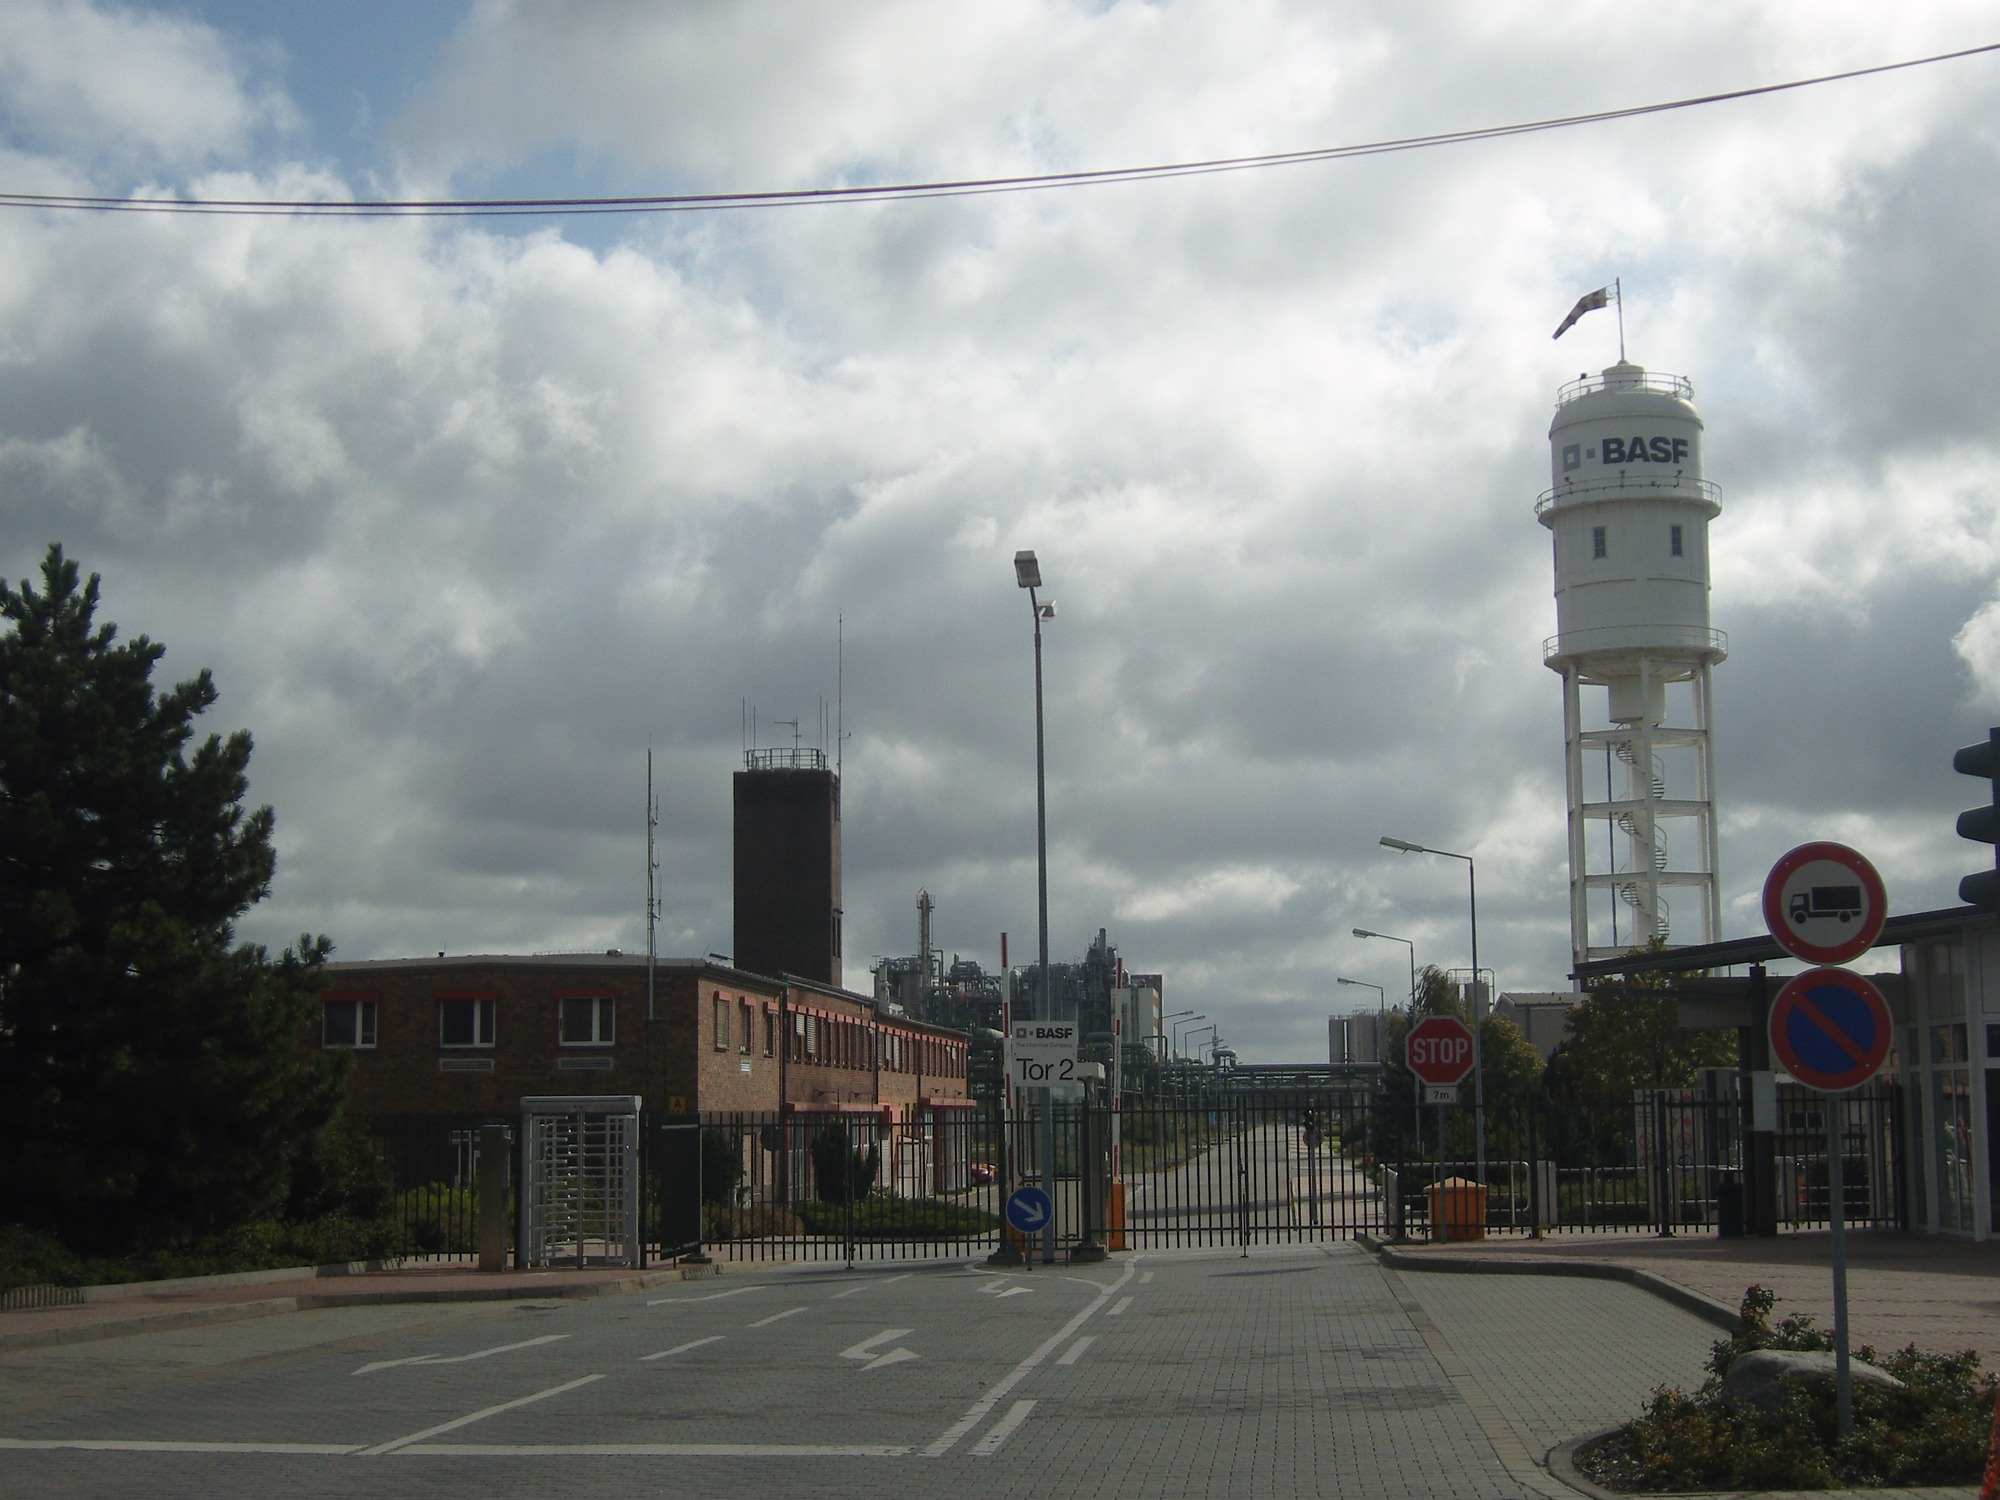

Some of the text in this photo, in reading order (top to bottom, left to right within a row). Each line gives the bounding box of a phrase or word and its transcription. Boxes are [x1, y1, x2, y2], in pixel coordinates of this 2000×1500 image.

[1602, 436, 1688, 464] BASF
[1036, 1027, 1073, 1039] BASF
[1413, 1037, 1468, 1064] STOP
[1016, 1058, 1074, 1081] Tor 2
